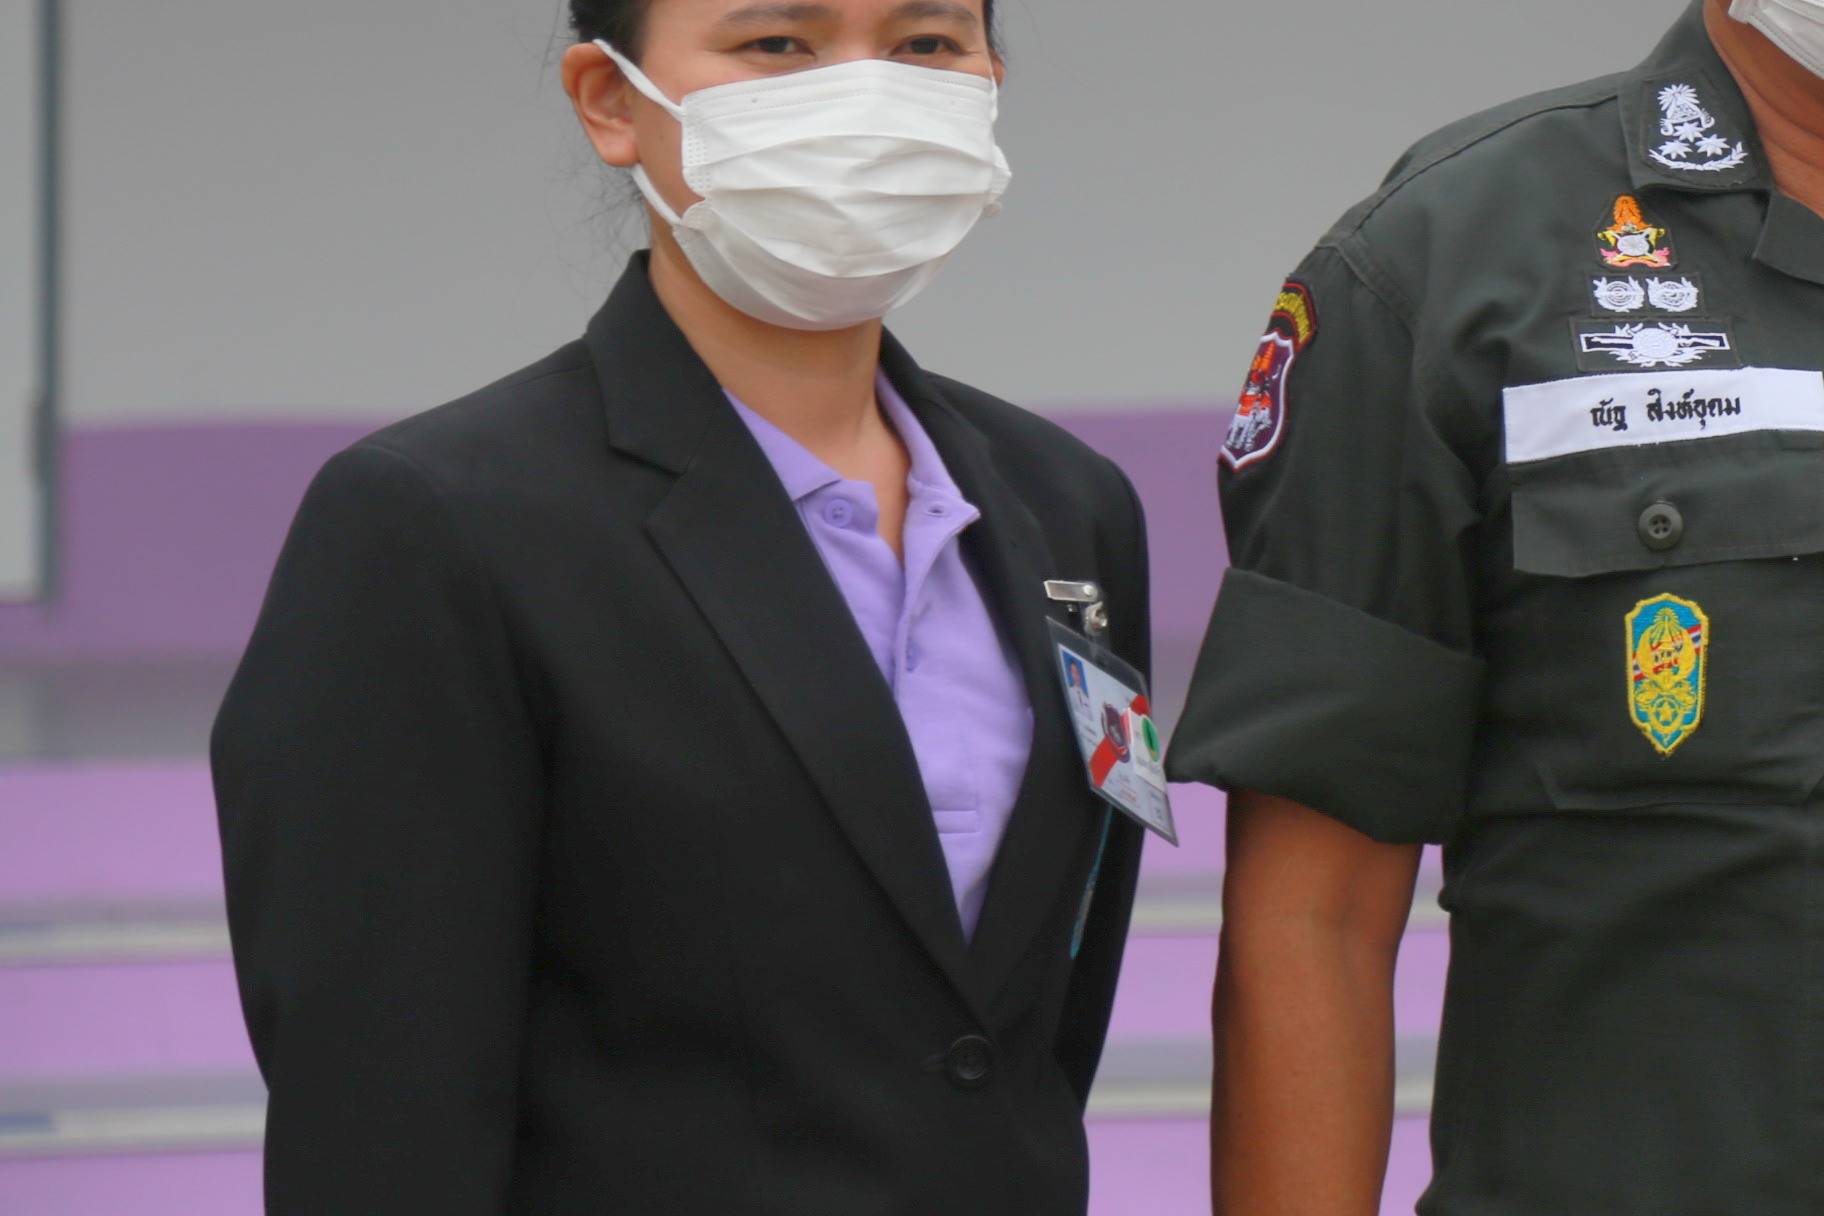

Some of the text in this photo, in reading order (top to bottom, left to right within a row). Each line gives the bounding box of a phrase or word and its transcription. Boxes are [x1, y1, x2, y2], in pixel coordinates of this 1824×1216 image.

[1590, 388, 1741, 431] ณัฐ สิงห์อุดม
